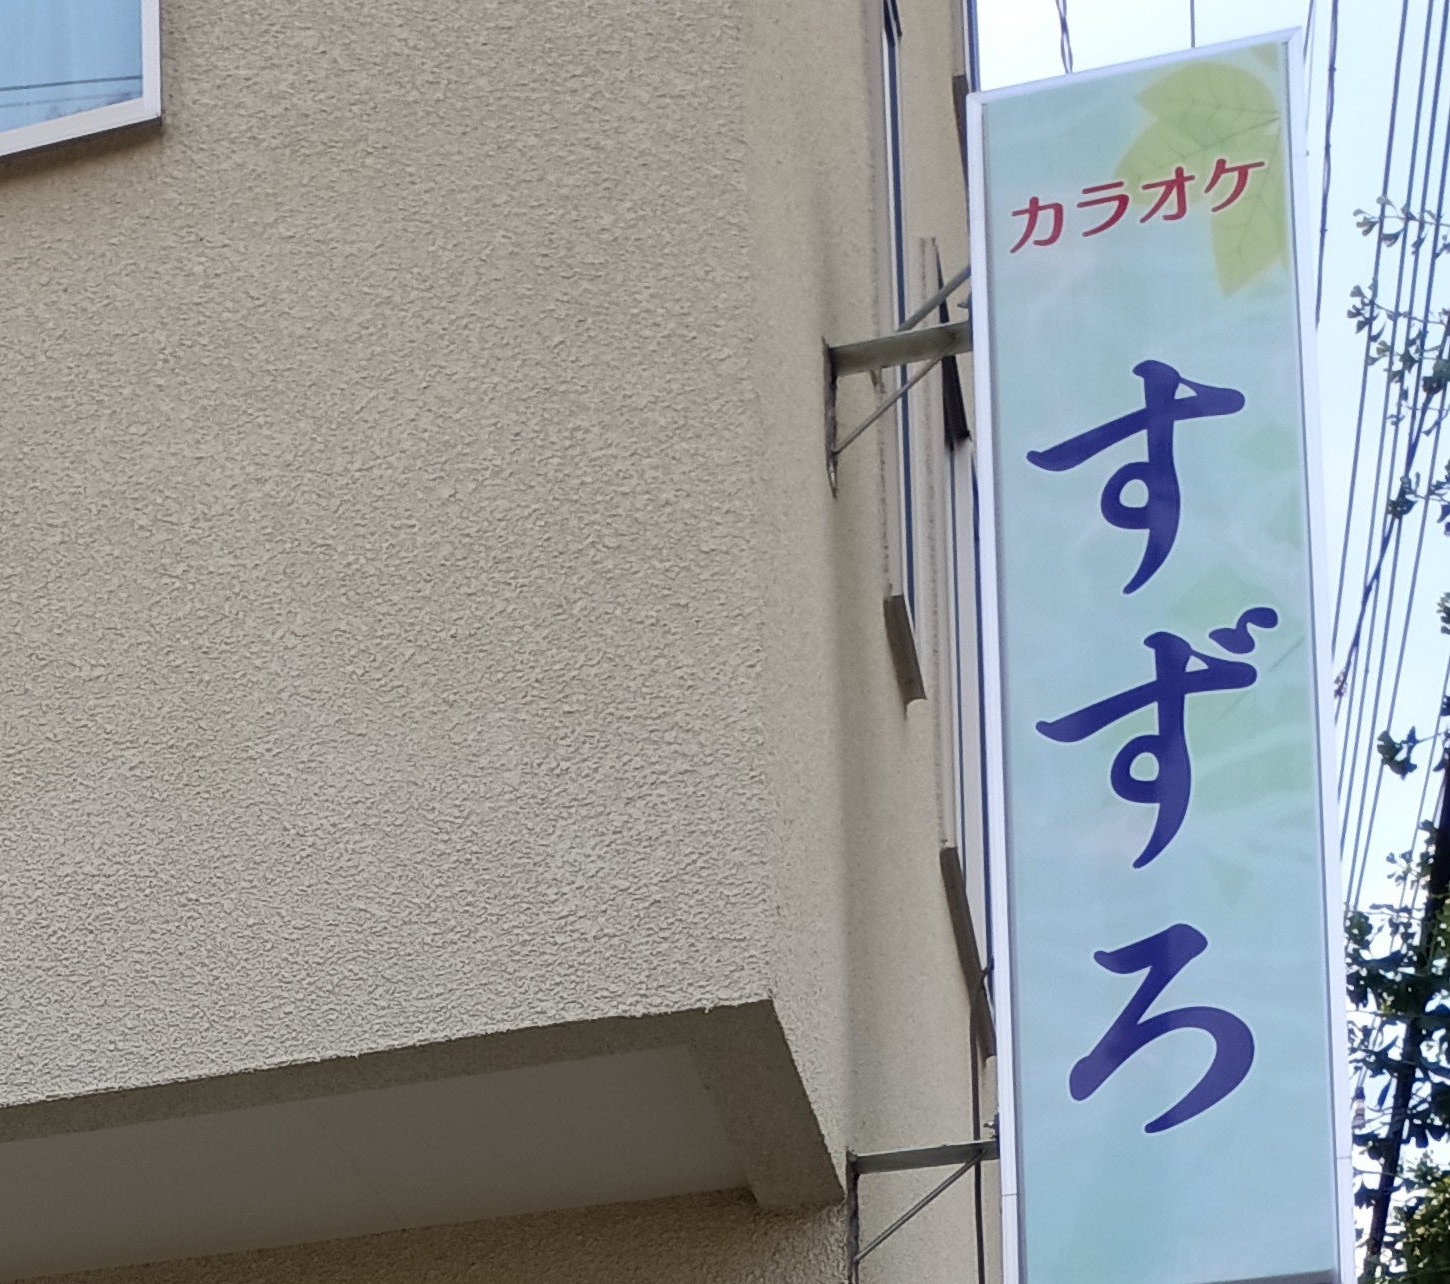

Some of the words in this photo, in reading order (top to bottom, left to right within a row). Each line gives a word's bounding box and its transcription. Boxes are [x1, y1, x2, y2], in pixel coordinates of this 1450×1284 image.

[1009, 157, 1265, 255] カラオケ
[1026, 359, 1279, 1135] すずろ
